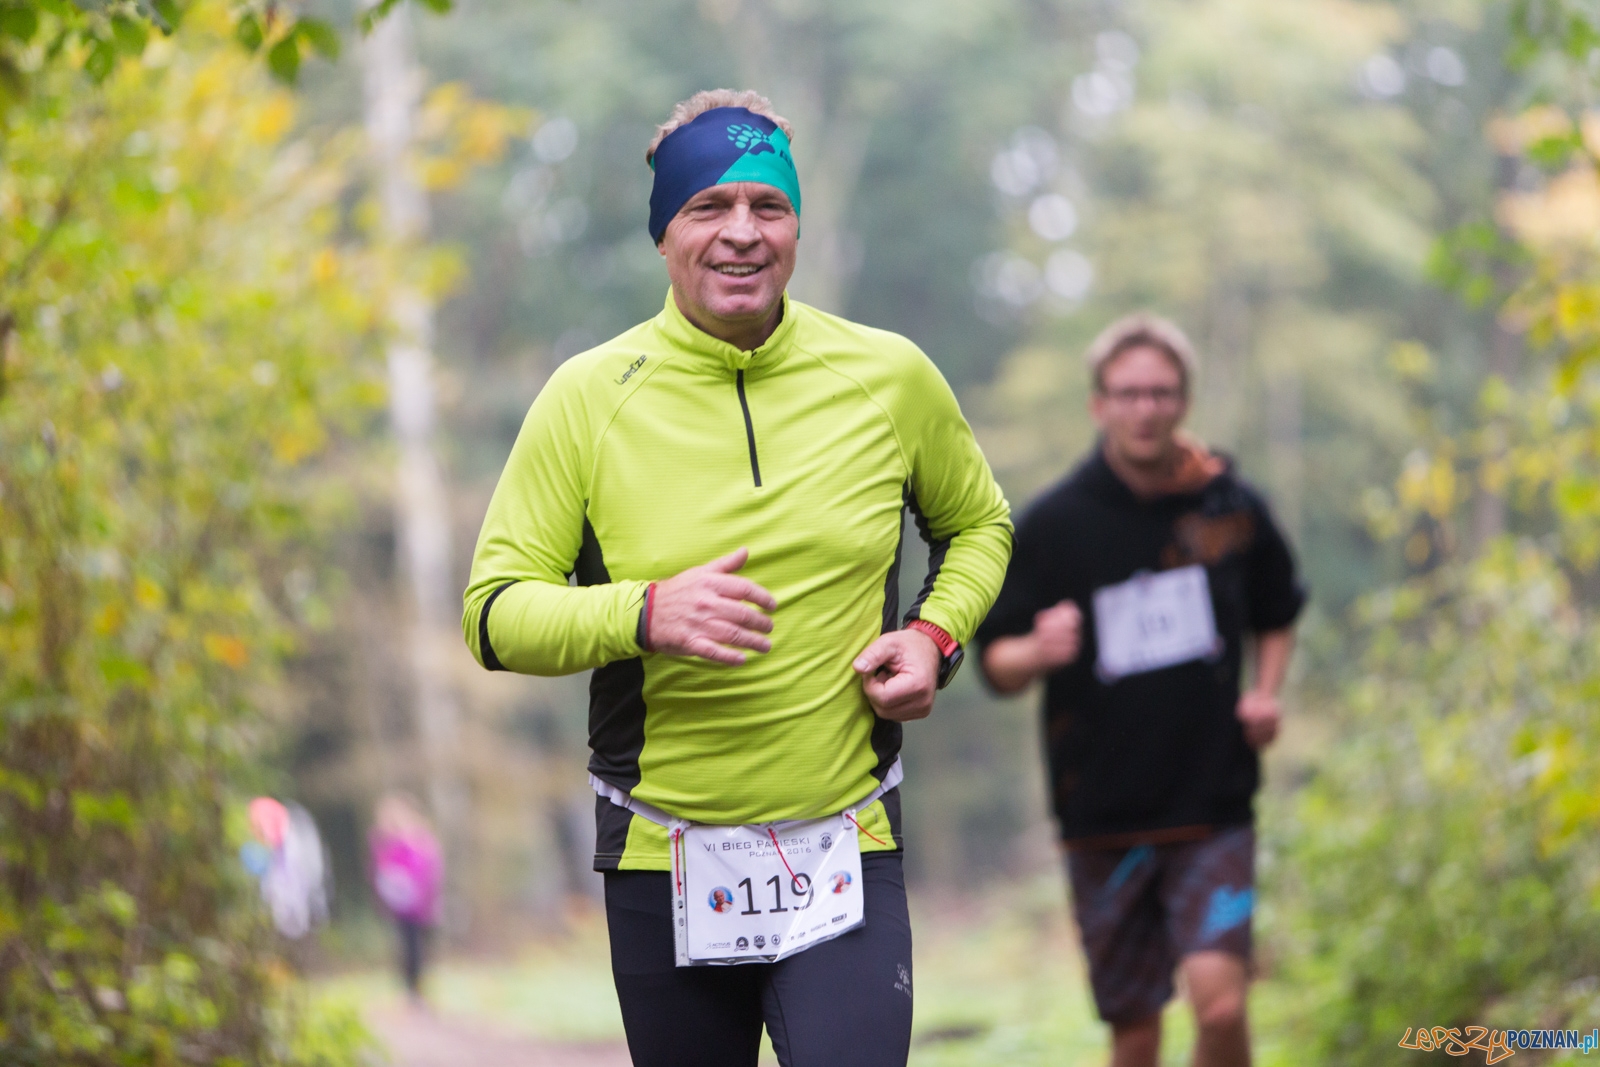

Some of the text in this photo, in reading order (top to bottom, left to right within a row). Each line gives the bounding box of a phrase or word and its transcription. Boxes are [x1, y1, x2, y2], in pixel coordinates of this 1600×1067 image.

[703, 843, 716, 852] VI
[722, 841, 752, 851] BIEG
[749, 846, 812, 858] POZNA 2016
[738, 872, 815, 916] 119
